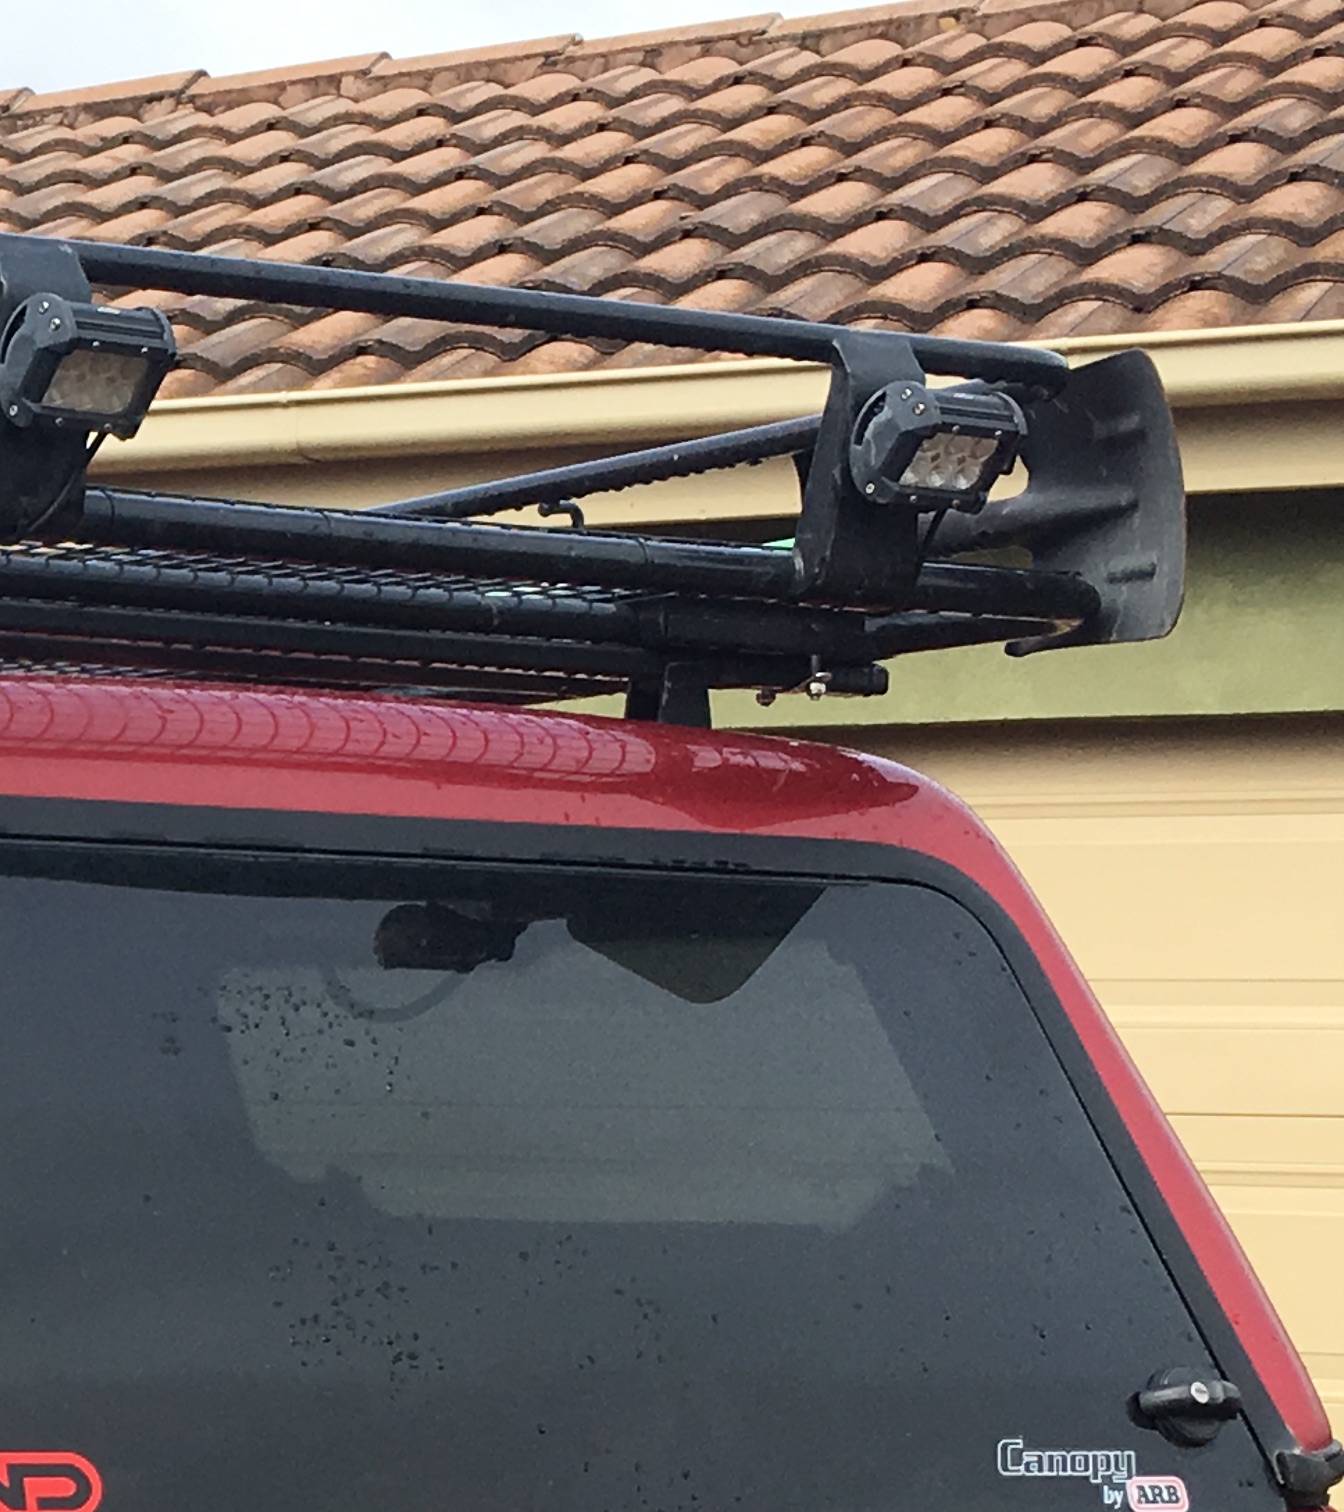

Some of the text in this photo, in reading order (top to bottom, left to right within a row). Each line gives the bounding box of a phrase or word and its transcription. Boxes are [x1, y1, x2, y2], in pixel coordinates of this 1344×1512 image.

[997, 1438, 1136, 1483] Canopy
[1103, 1484, 1182, 1510] by ARB
